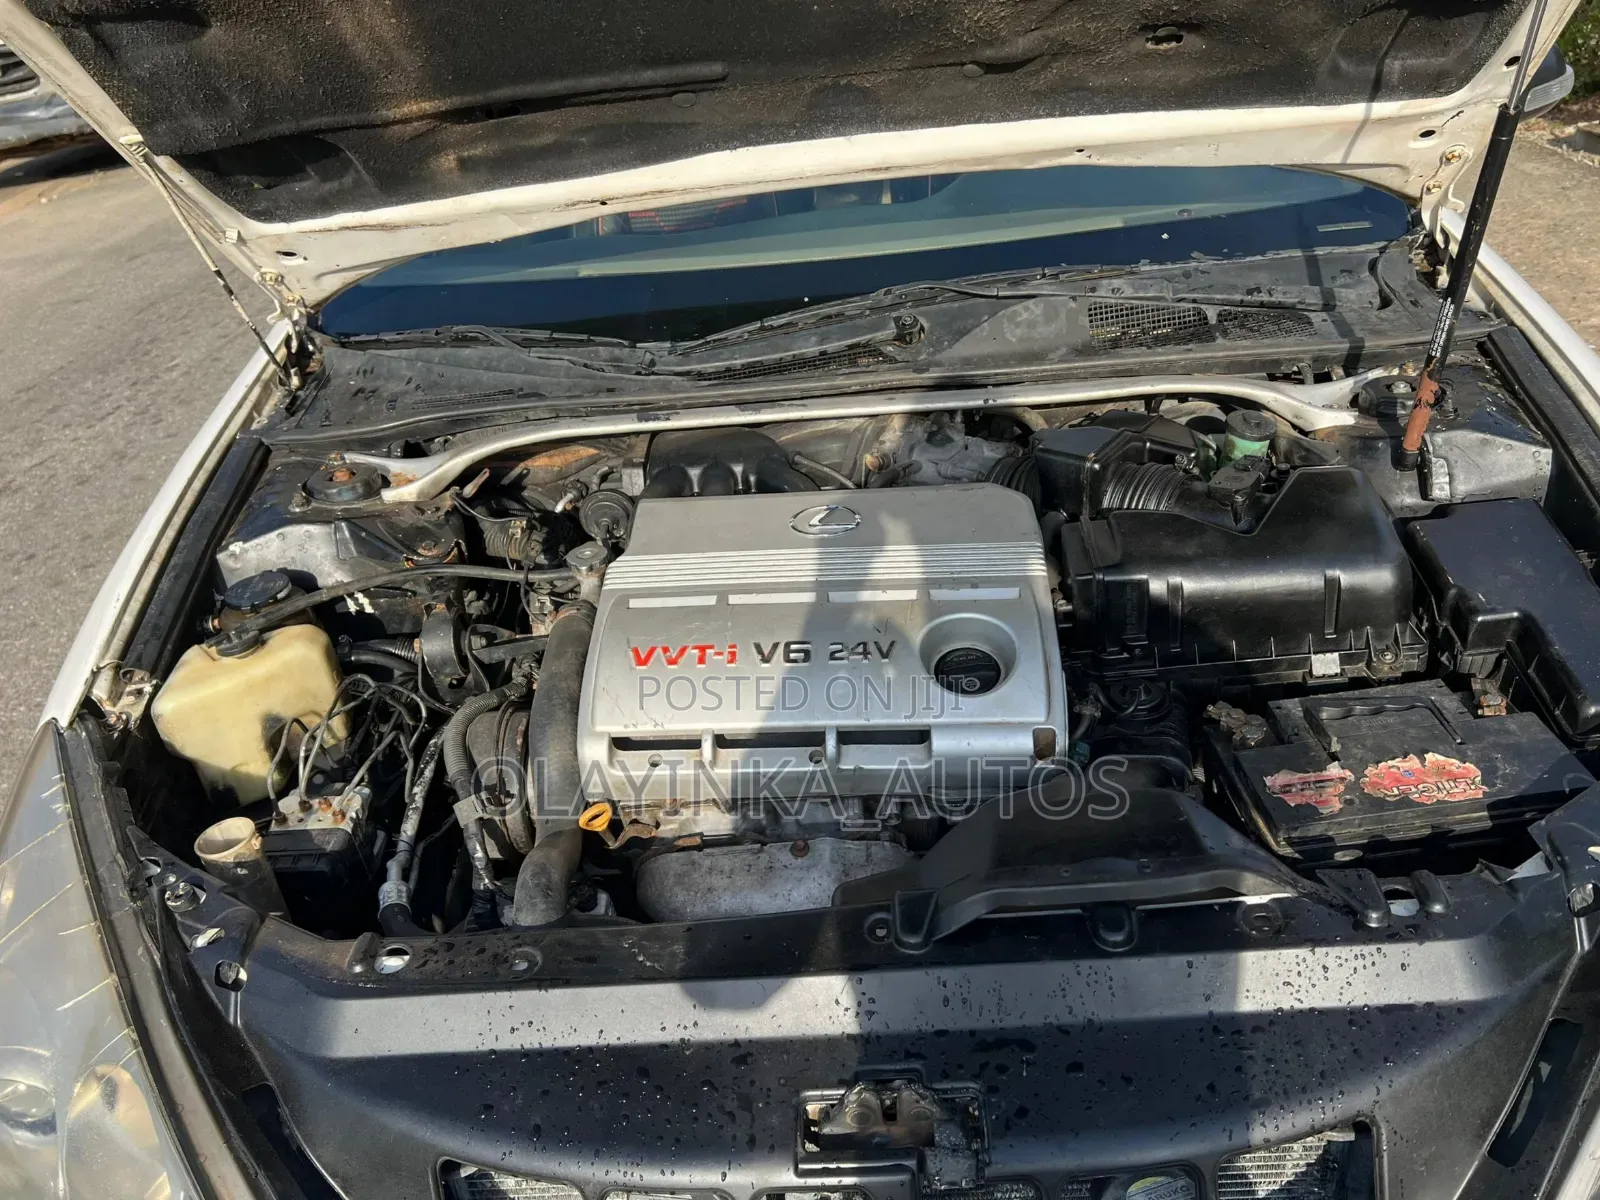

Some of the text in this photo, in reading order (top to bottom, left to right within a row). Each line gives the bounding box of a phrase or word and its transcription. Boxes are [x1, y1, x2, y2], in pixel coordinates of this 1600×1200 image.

[631, 639, 896, 668] VVT-i V6 24V
